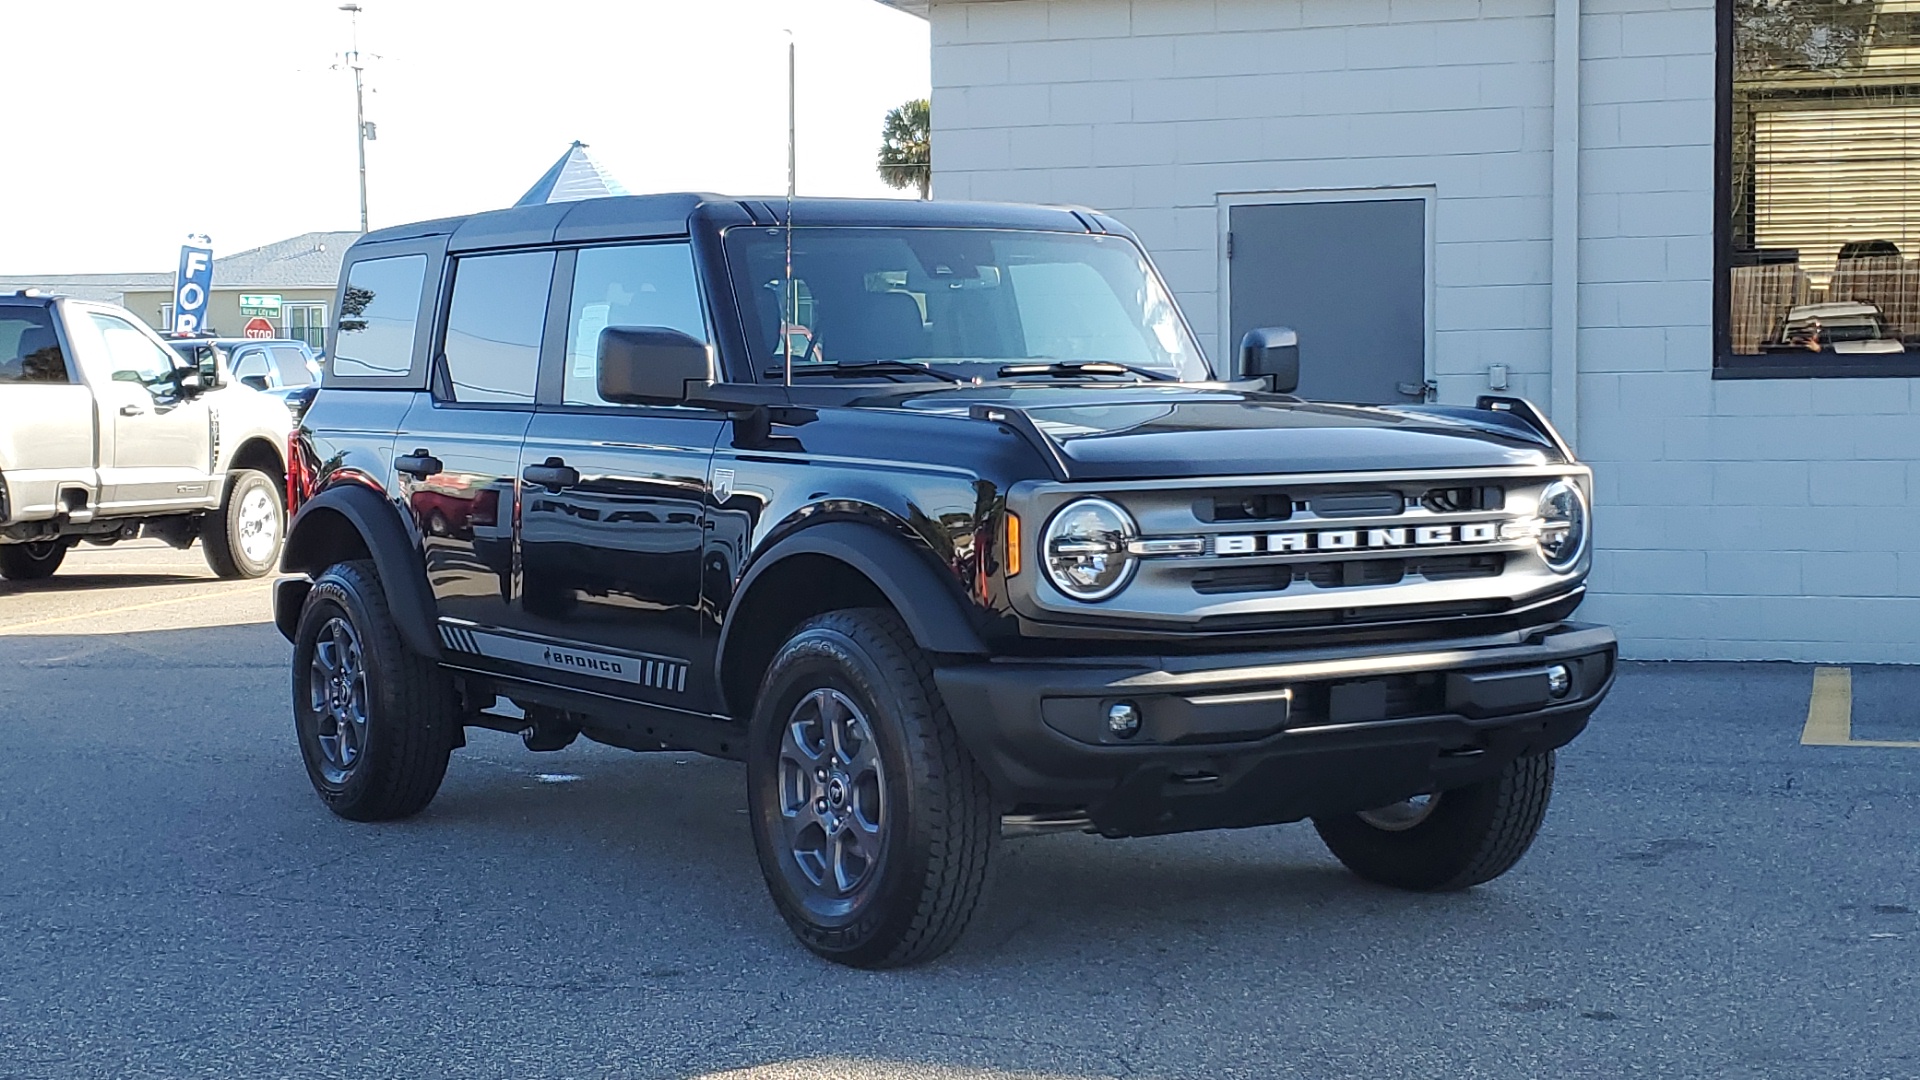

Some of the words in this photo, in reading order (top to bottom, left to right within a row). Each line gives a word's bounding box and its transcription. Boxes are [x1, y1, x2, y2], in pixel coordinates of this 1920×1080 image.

[177, 251, 208, 332] FOR
[247, 329, 272, 339] STOP
[1214, 522, 1496, 555] BRONCO
[553, 652, 622, 674] BRONCO
